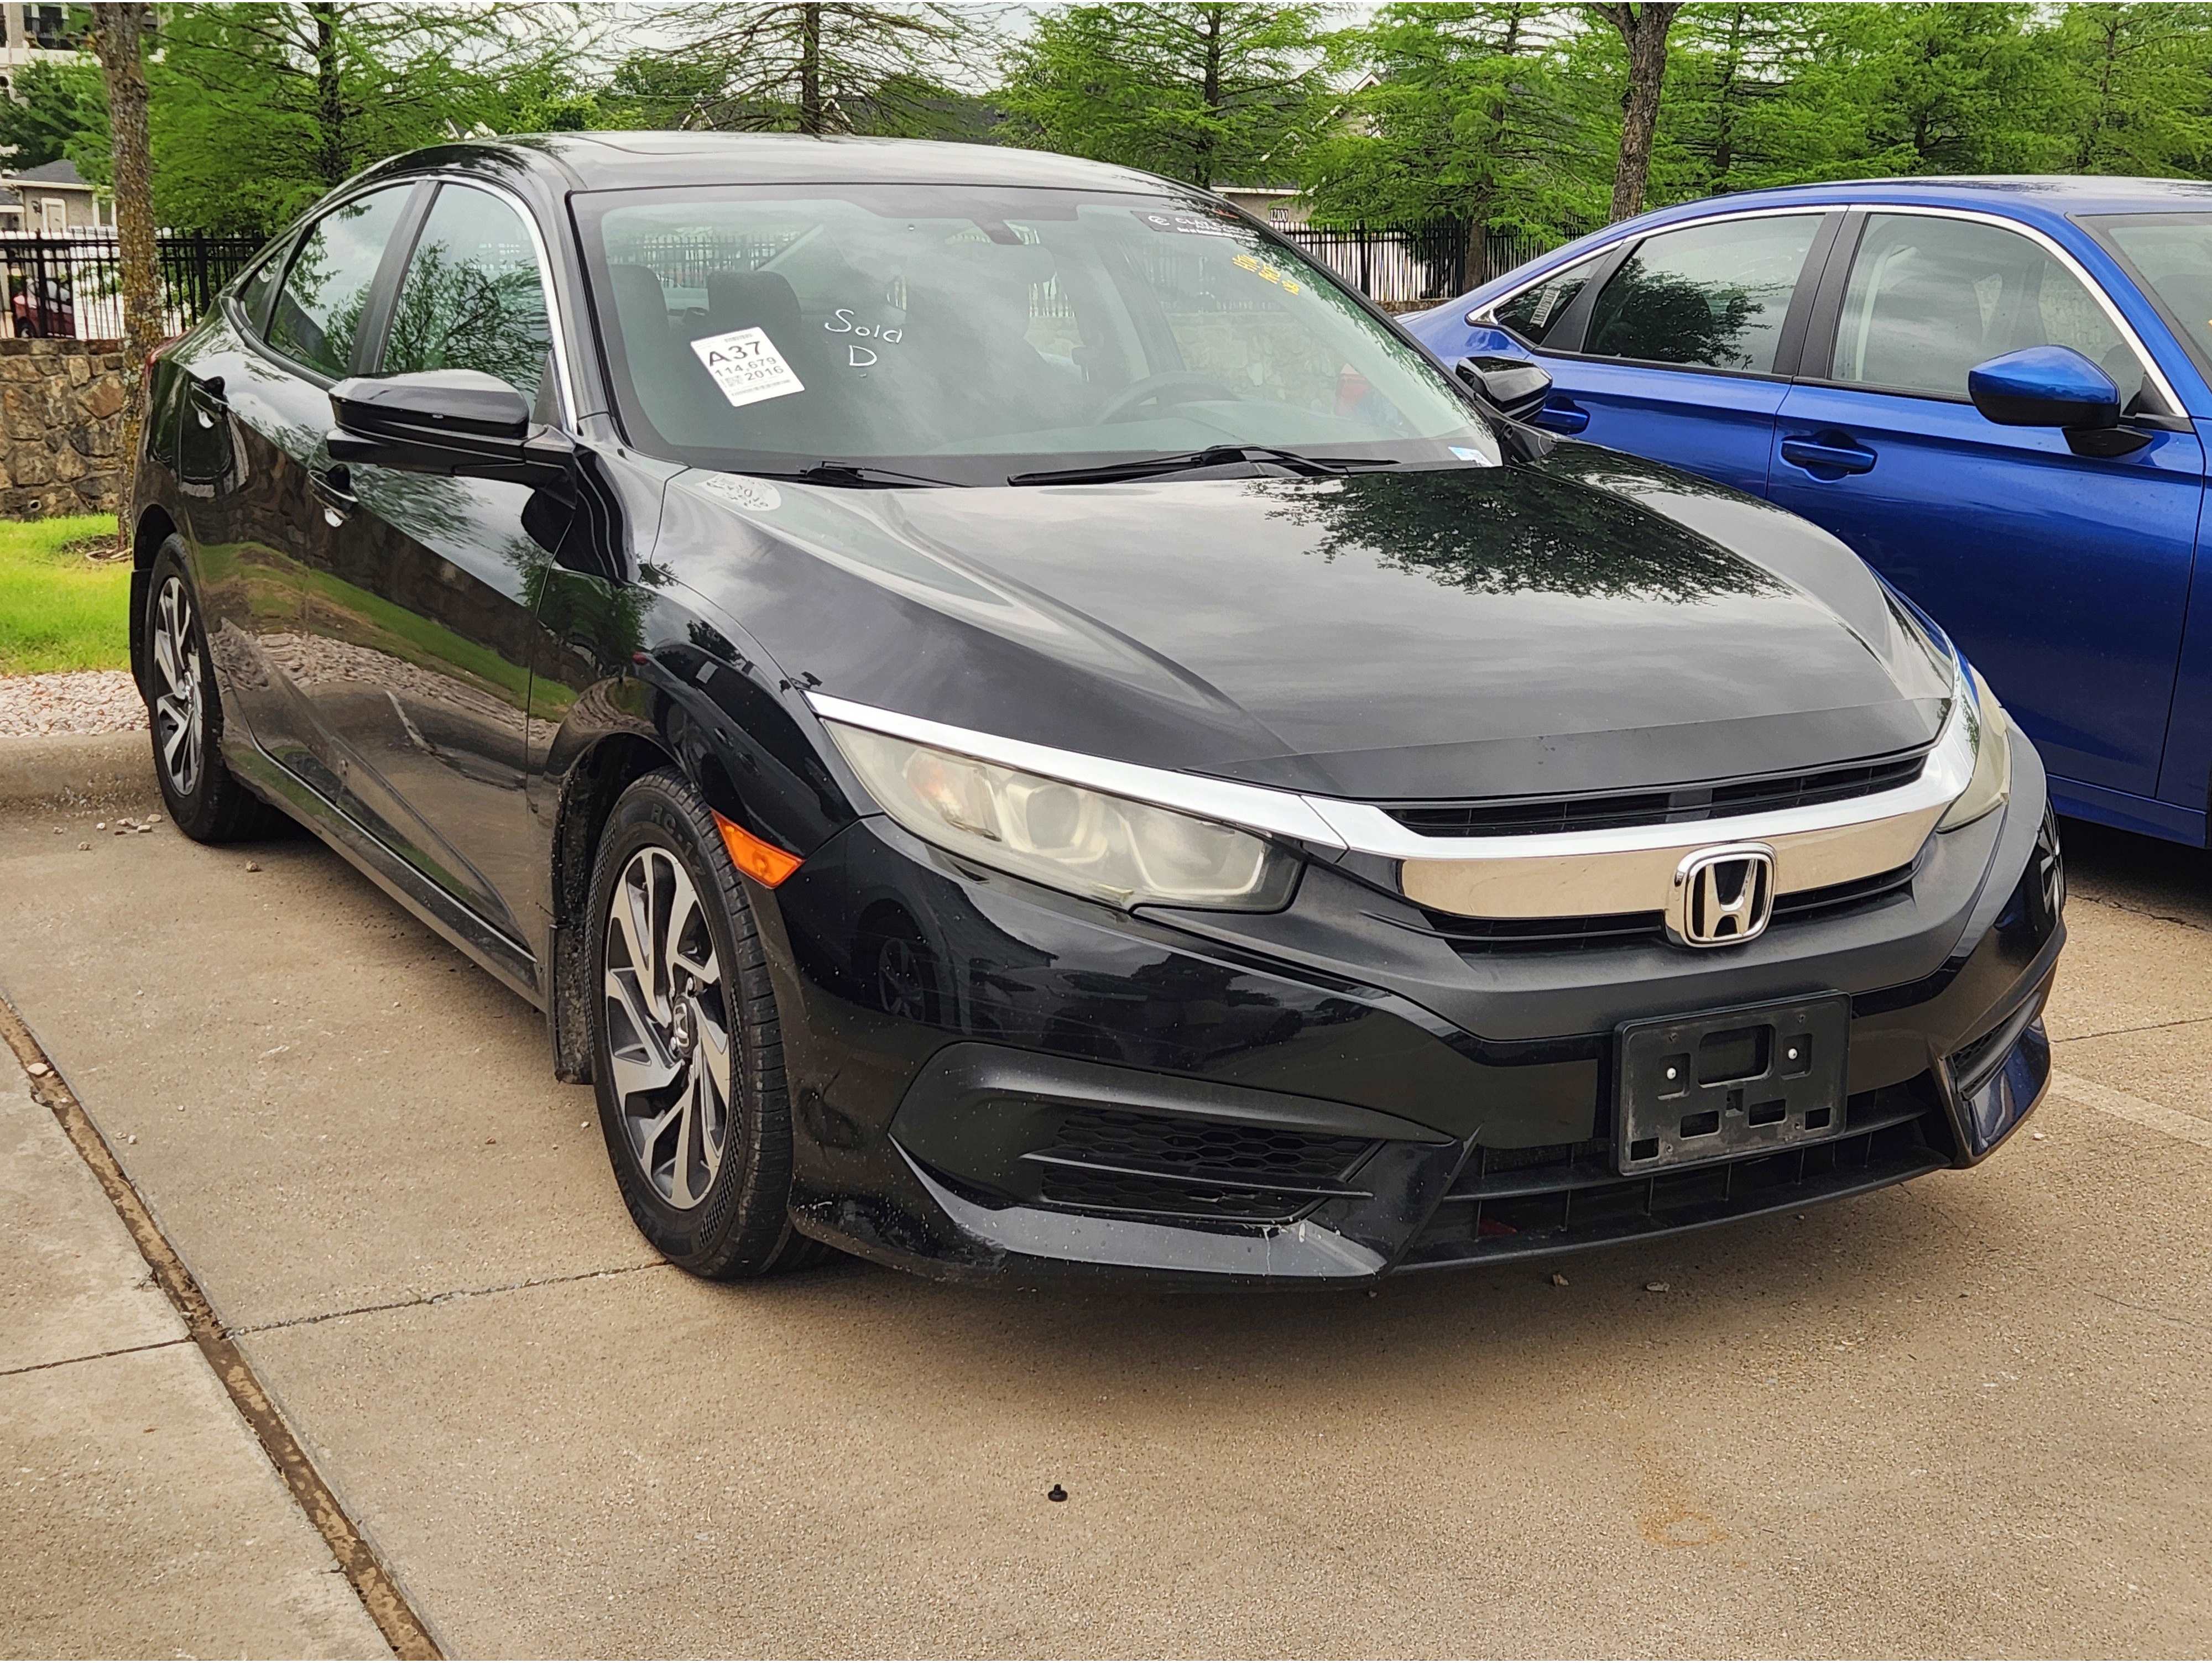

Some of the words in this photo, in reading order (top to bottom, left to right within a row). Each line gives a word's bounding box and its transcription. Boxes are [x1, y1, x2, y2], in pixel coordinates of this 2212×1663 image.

[1270, 210, 1288, 221] 12100
[824, 308, 902, 344] Sold
[709, 341, 761, 367] A37
[848, 344, 878, 367] D
[744, 365, 784, 381] 2016
